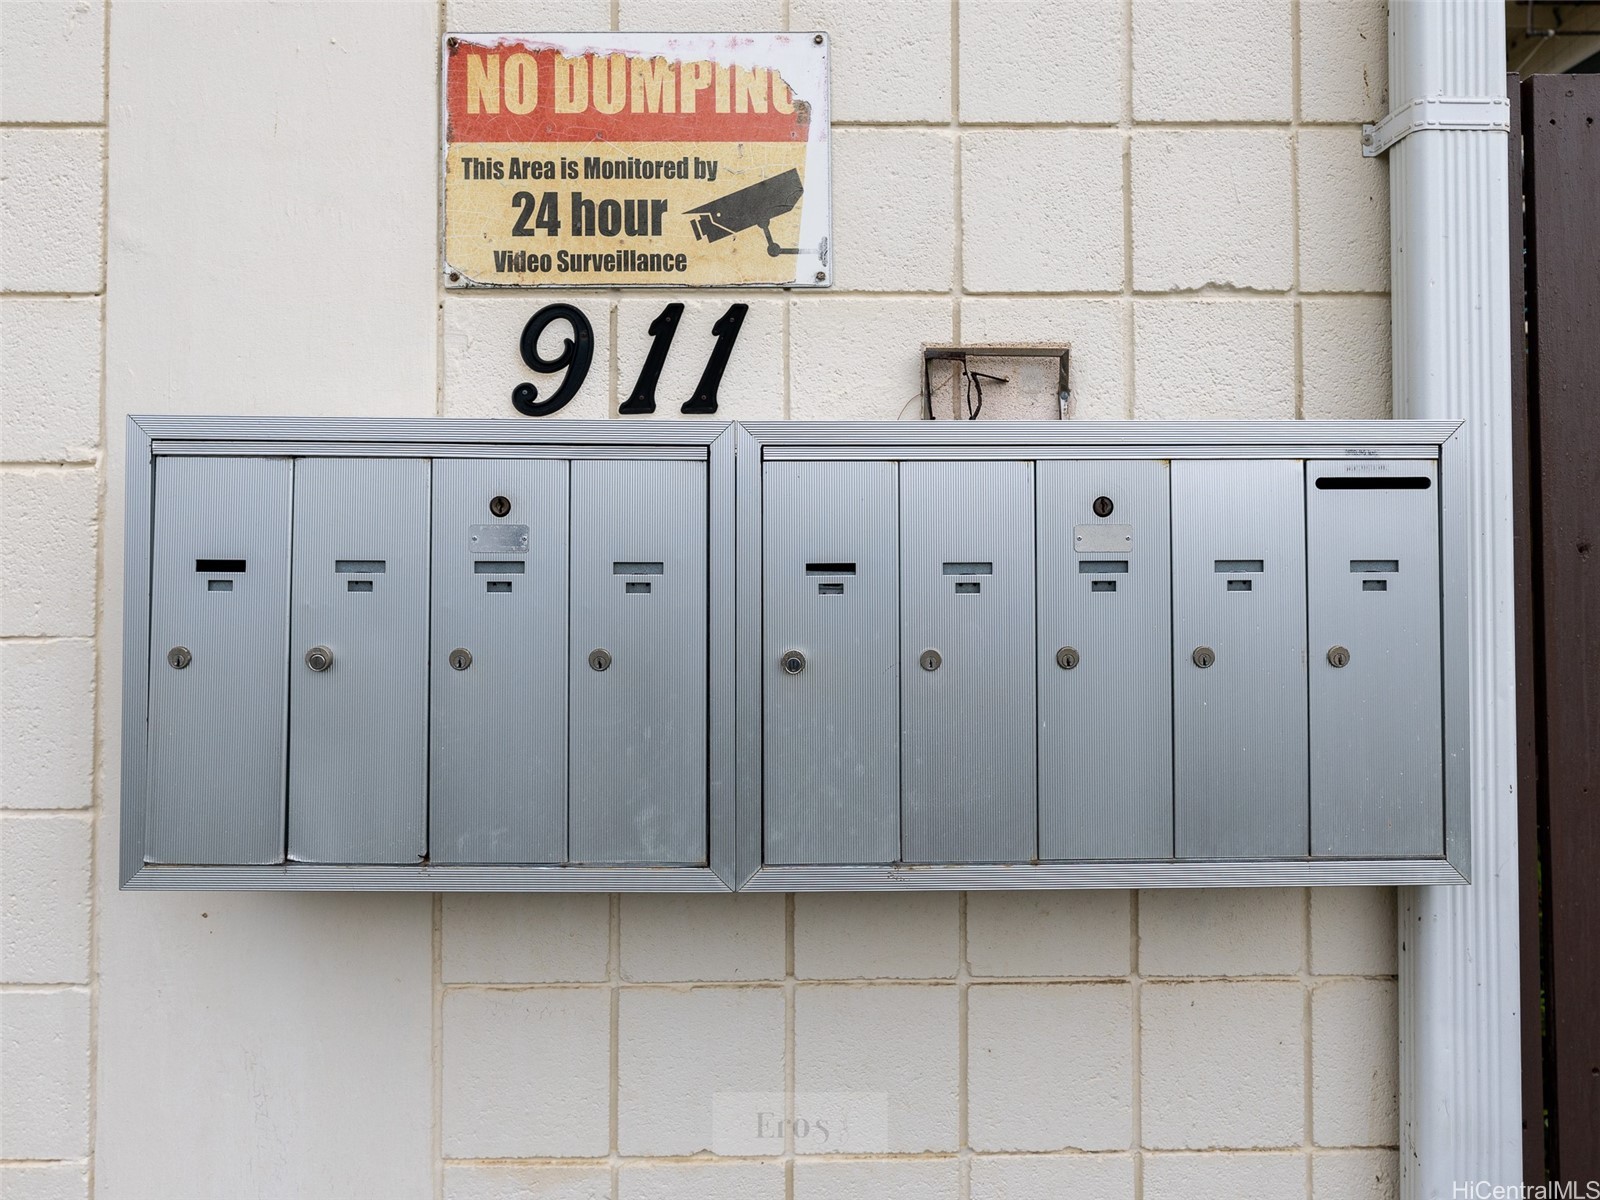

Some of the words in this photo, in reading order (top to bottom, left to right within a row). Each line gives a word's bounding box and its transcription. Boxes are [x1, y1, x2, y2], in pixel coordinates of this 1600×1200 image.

[466, 52, 538, 115] NO
[461, 157, 504, 180] This
[509, 157, 556, 180] Area
[561, 157, 579, 180] is
[584, 157, 689, 180] Monitored
[694, 157, 718, 181] by
[511, 191, 561, 237] 24
[571, 191, 668, 237] hour
[493, 250, 552, 273] Video
[556, 250, 687, 273] Surveillance
[511, 302, 749, 417] 911
